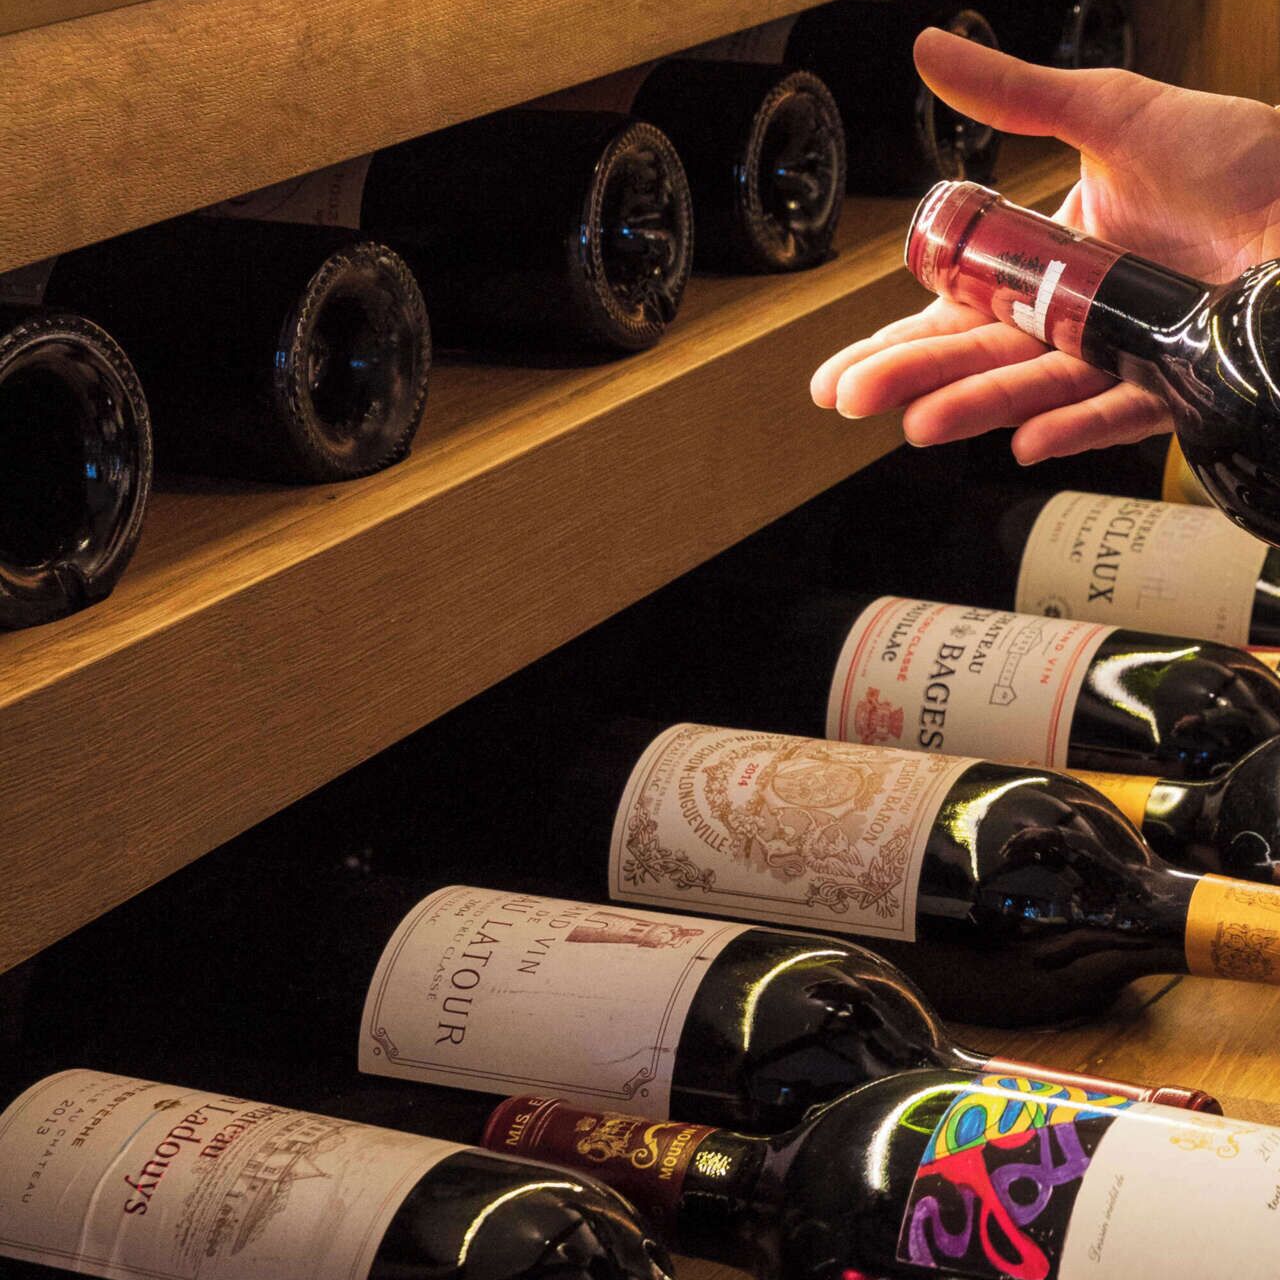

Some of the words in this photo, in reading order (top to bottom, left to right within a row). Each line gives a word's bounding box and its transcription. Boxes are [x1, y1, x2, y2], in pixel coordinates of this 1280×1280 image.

[1040, 658, 1057, 684] VIN
[918, 643, 967, 749] BAGES
[738, 763, 759, 787] 2014
[862, 795, 901, 846] BARON
[517, 938, 557, 975] VIN
[434, 919, 514, 1046] LATOUR
[36, 1099, 74, 1135] 2013
[505, 1114, 530, 1147] MIS
[124, 1103, 237, 1216] Ladouys
[658, 1127, 698, 1180] MOUTON
